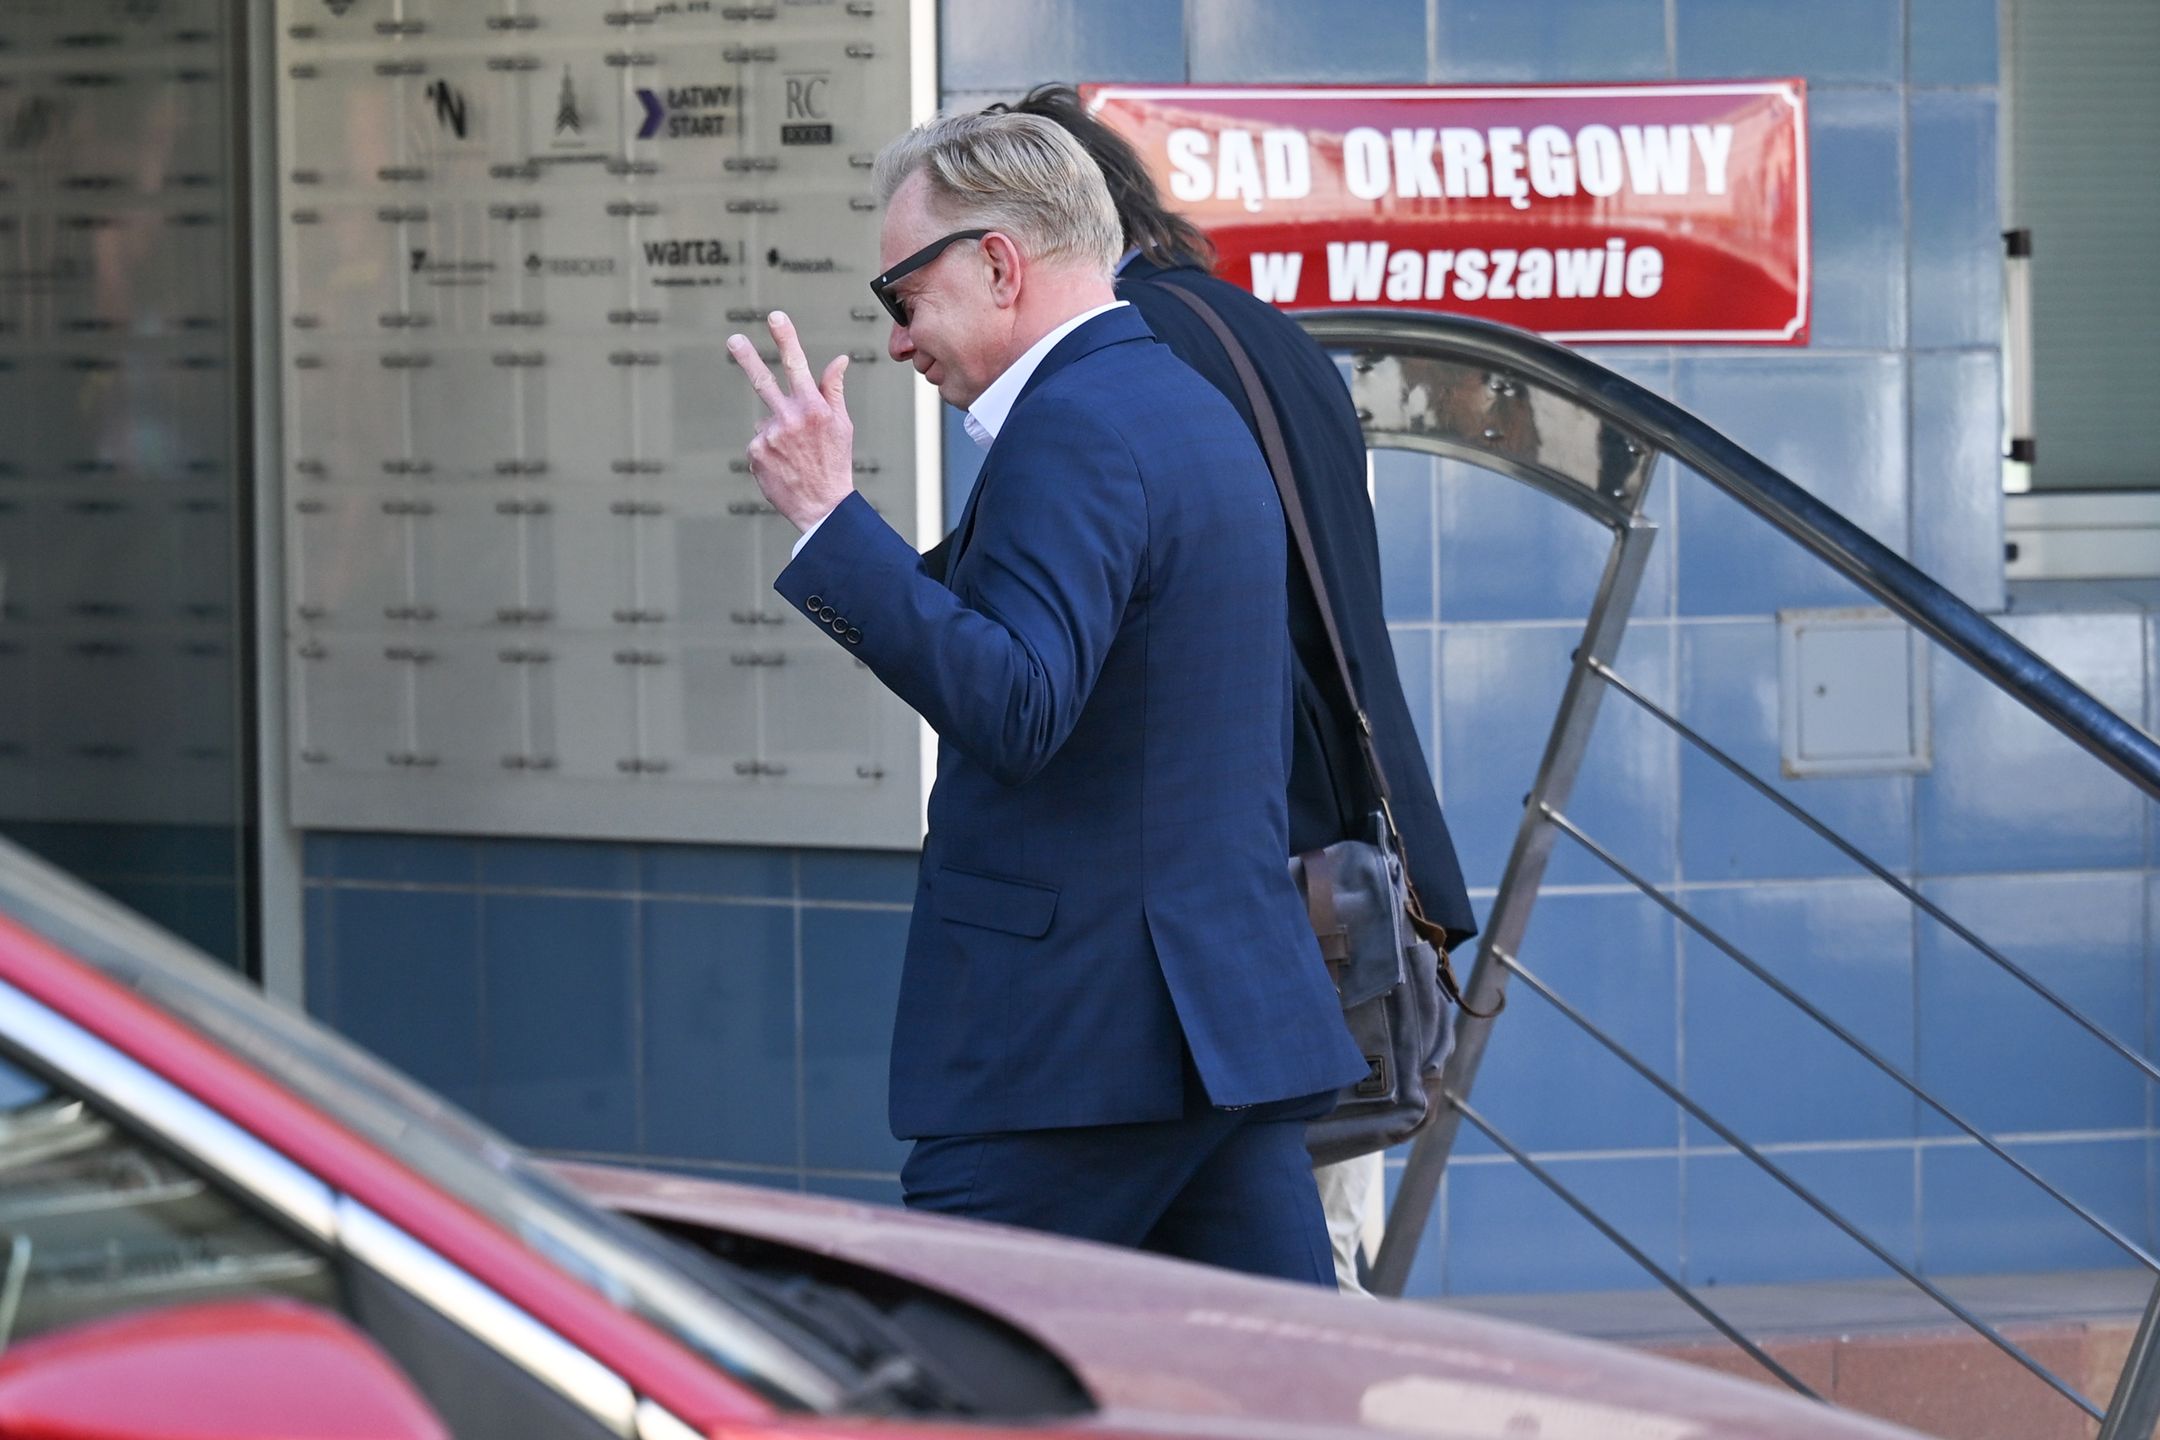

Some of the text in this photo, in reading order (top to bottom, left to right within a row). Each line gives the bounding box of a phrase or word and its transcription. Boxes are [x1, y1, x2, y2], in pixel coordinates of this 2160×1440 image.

[668, 86, 732, 109] ŁATWY
[786, 78, 829, 119] RC
[669, 115, 725, 137] START
[1167, 124, 1733, 213] SĄD OKRĘGOWY
[643, 239, 730, 266] warta.
[1250, 237, 1664, 303] w Warszawie
